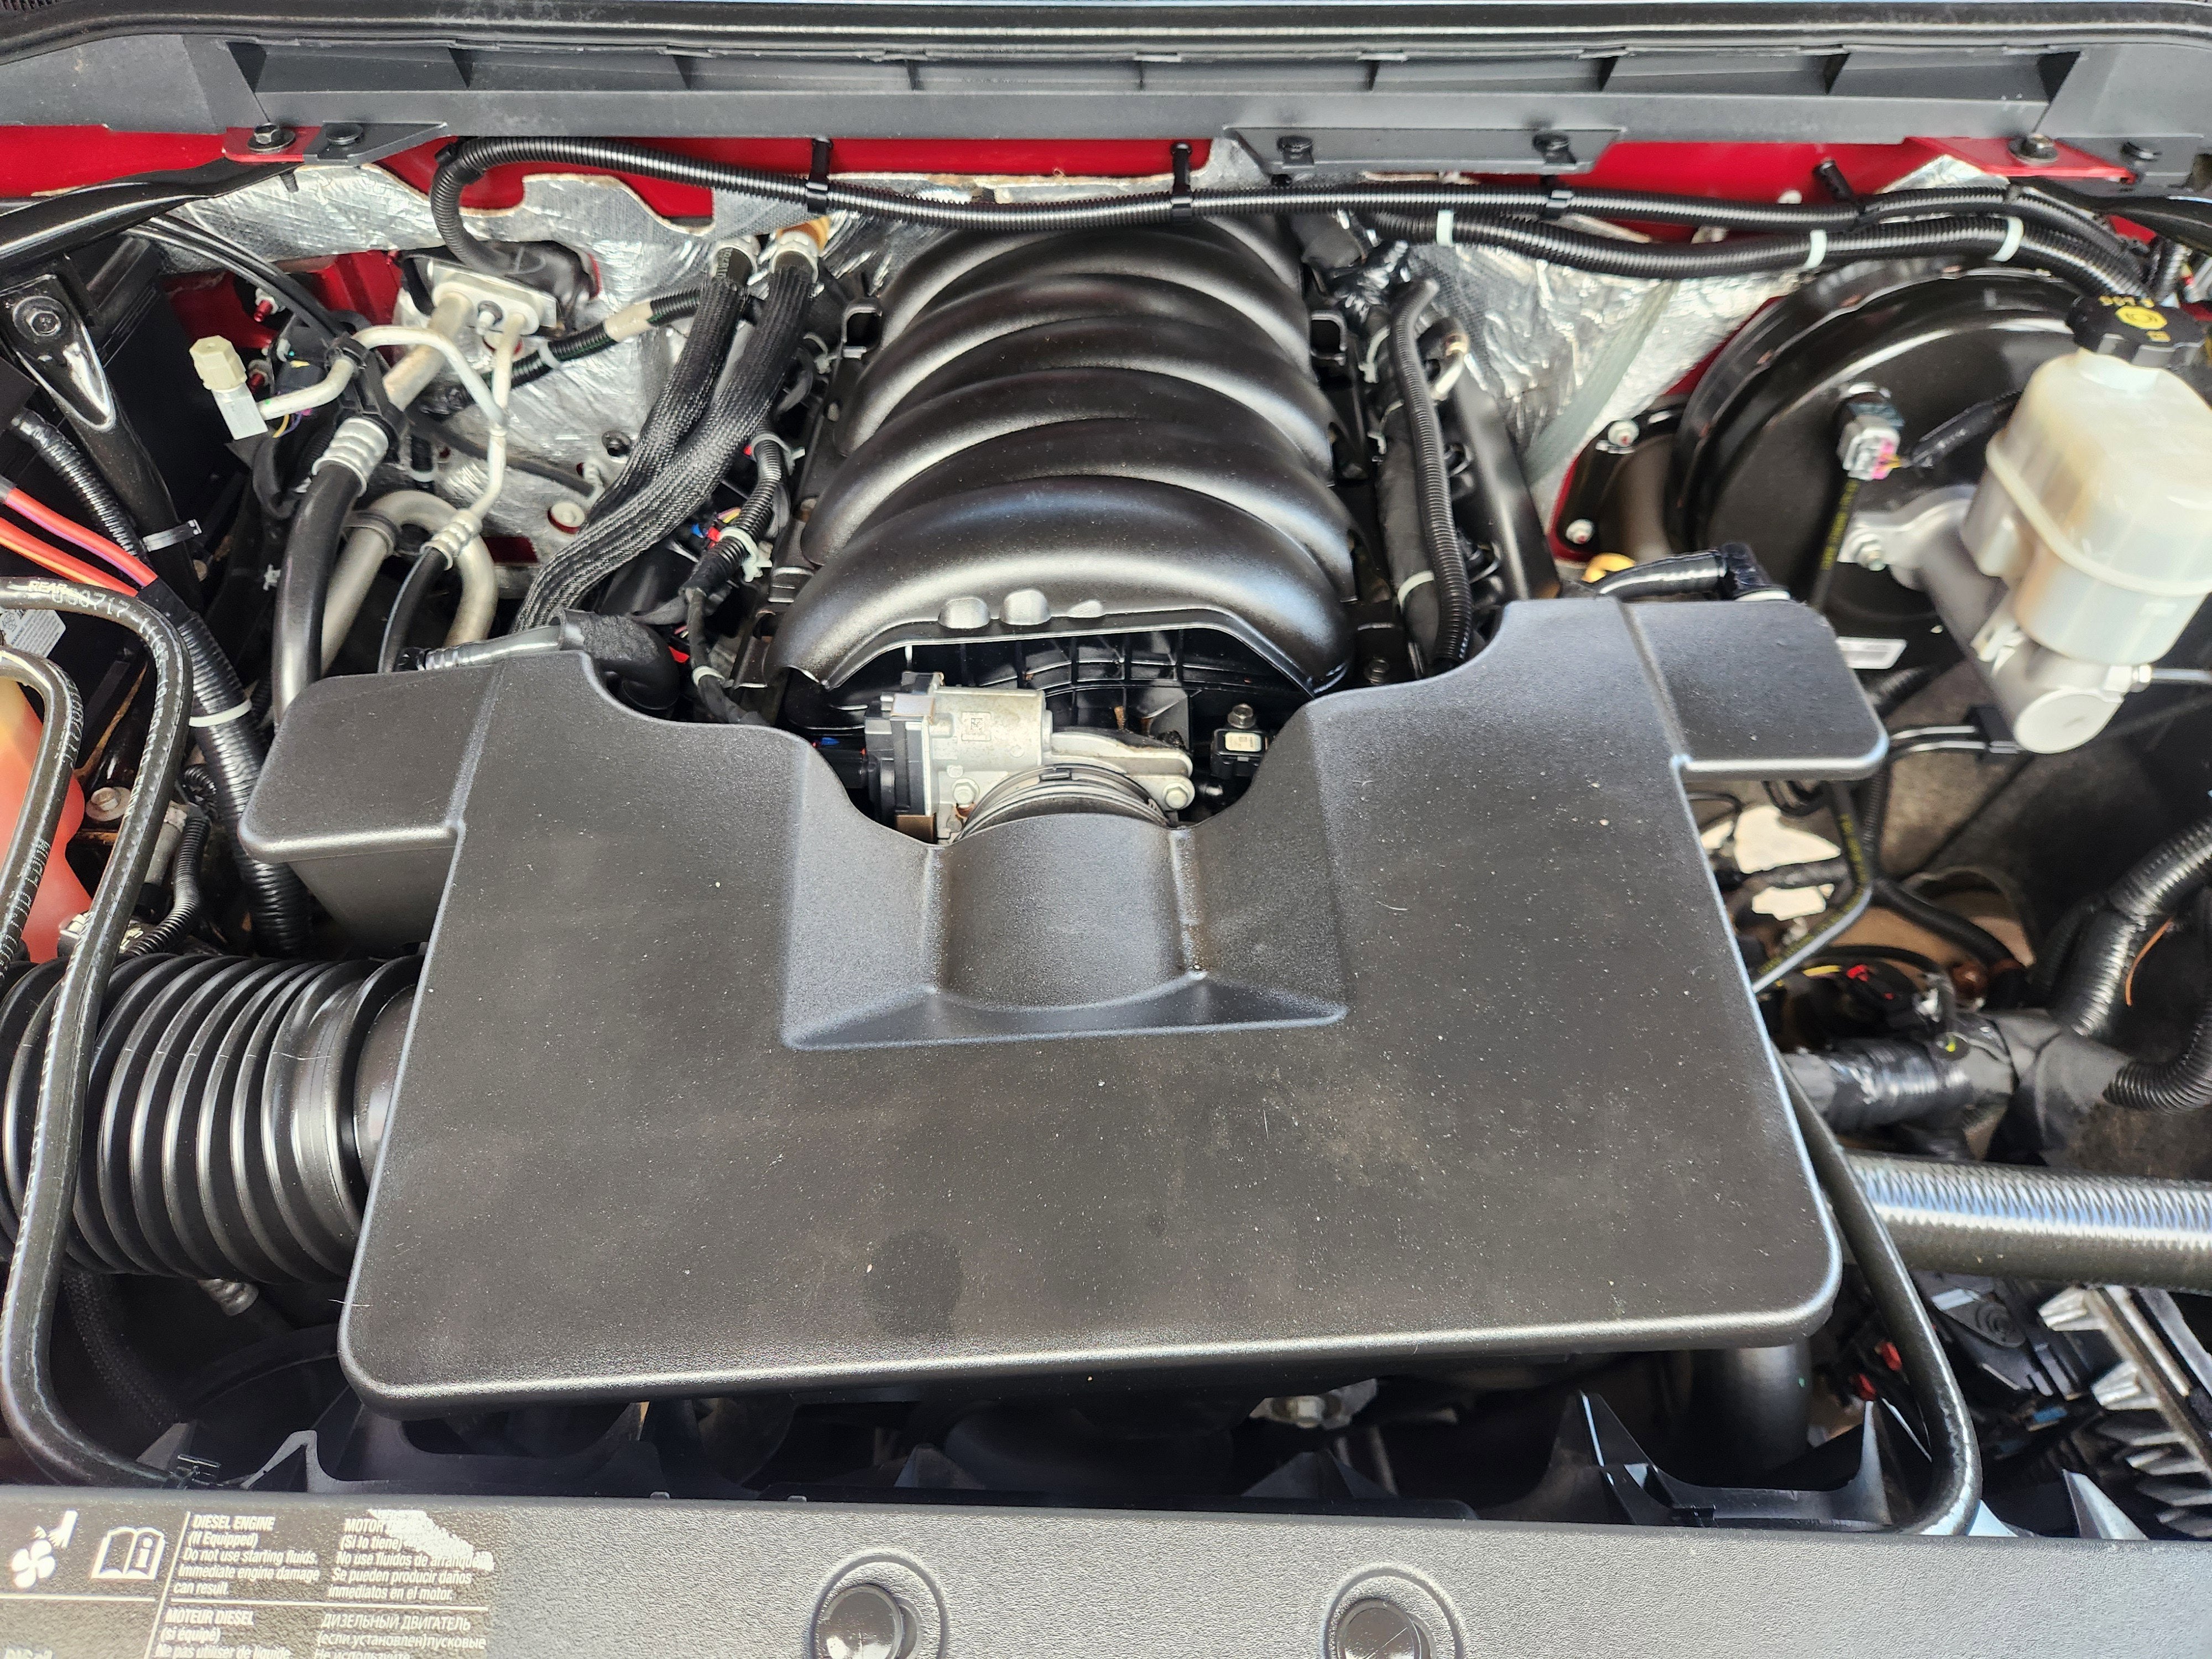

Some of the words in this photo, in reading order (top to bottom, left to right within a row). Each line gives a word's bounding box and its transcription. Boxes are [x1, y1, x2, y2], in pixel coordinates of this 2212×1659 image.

[192, 1514, 231, 1530] DIESEL
[233, 1515, 276, 1531] ENGINE
[344, 1518, 384, 1532] MOTOR
[188, 1531, 202, 1546] (If
[203, 1532, 259, 1548] Equipped)
[339, 1535, 357, 1551] (Si
[357, 1535, 369, 1549] lo
[371, 1535, 403, 1552] tiene)
[183, 1547, 199, 1561] Do
[200, 1548, 220, 1562] not
[220, 1550, 240, 1563] use
[242, 1550, 284, 1566] starting
[285, 1550, 318, 1565] fluids.
[336, 1551, 352, 1565] No
[353, 1553, 374, 1566] use
[376, 1552, 413, 1567] fluidos
[414, 1553, 429, 1567] de
[178, 1563, 236, 1578] Immediate
[237, 1566, 274, 1582] engine
[276, 1566, 320, 1583] damage
[332, 1567, 347, 1581] Se
[348, 1568, 389, 1584] pueden
[390, 1569, 437, 1585] producir
[438, 1569, 472, 1584] daños
[173, 1582, 194, 1594] can
[195, 1581, 229, 1595] result.
[328, 1584, 388, 1599] inmediatos
[390, 1588, 404, 1600] en
[406, 1586, 418, 1600] el
[165, 1608, 214, 1624] MOTEUR
[214, 1610, 254, 1625] DIESEL
[321, 1613, 399, 1630] ДИЗЕЛЬНЫЙ
[400, 1615, 471, 1631] ДВИГАТЕЛЬ
[160, 1626, 177, 1642] (si
[178, 1626, 221, 1645] équipé)
[317, 1630, 350, 1647] (если
[173, 1645, 195, 1659] pas
[236, 1645, 252, 1659] de
